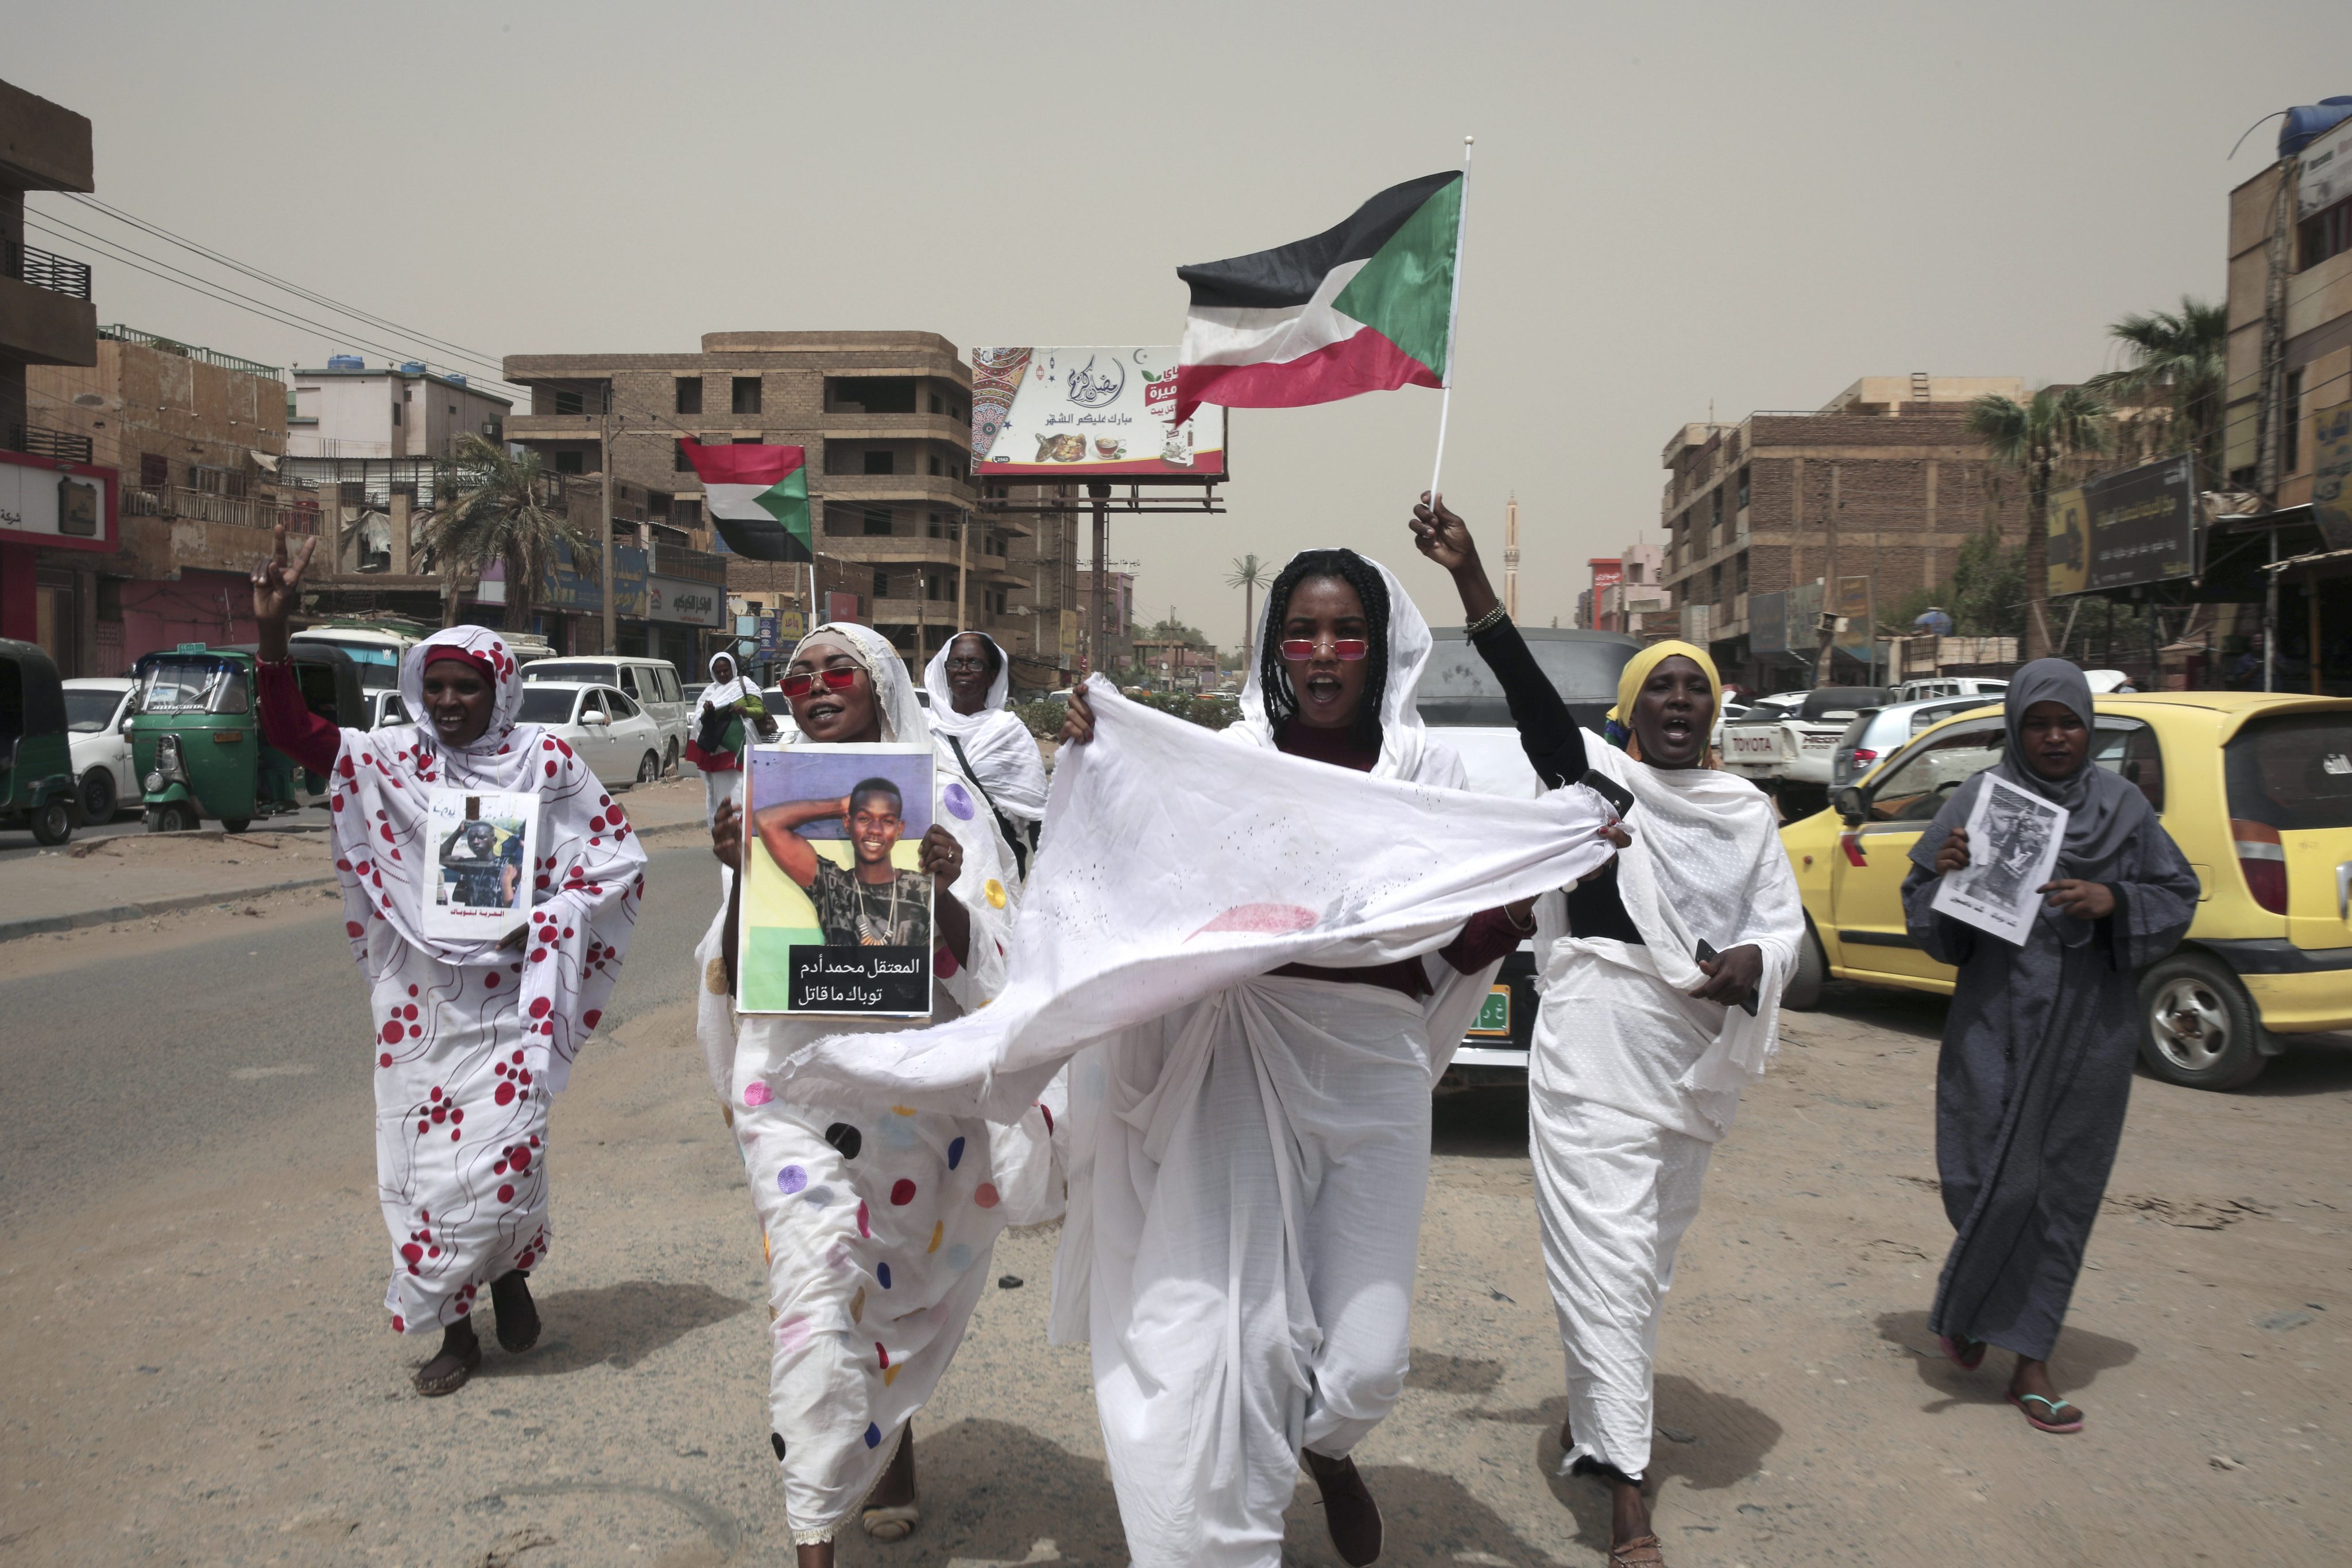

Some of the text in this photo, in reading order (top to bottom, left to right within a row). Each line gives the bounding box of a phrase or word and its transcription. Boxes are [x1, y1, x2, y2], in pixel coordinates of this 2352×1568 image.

[1076, 413, 1106, 425] عليكم
[1108, 413, 1132, 425] مبارك
[0, 509, 22, 525] شركة
[1732, 737, 1773, 752] TOYOTA
[479, 909, 505, 917] الحرية
[800, 954, 919, 979] المعتقل محمد أدم
[798, 985, 883, 1006] توباك ما قاتل
